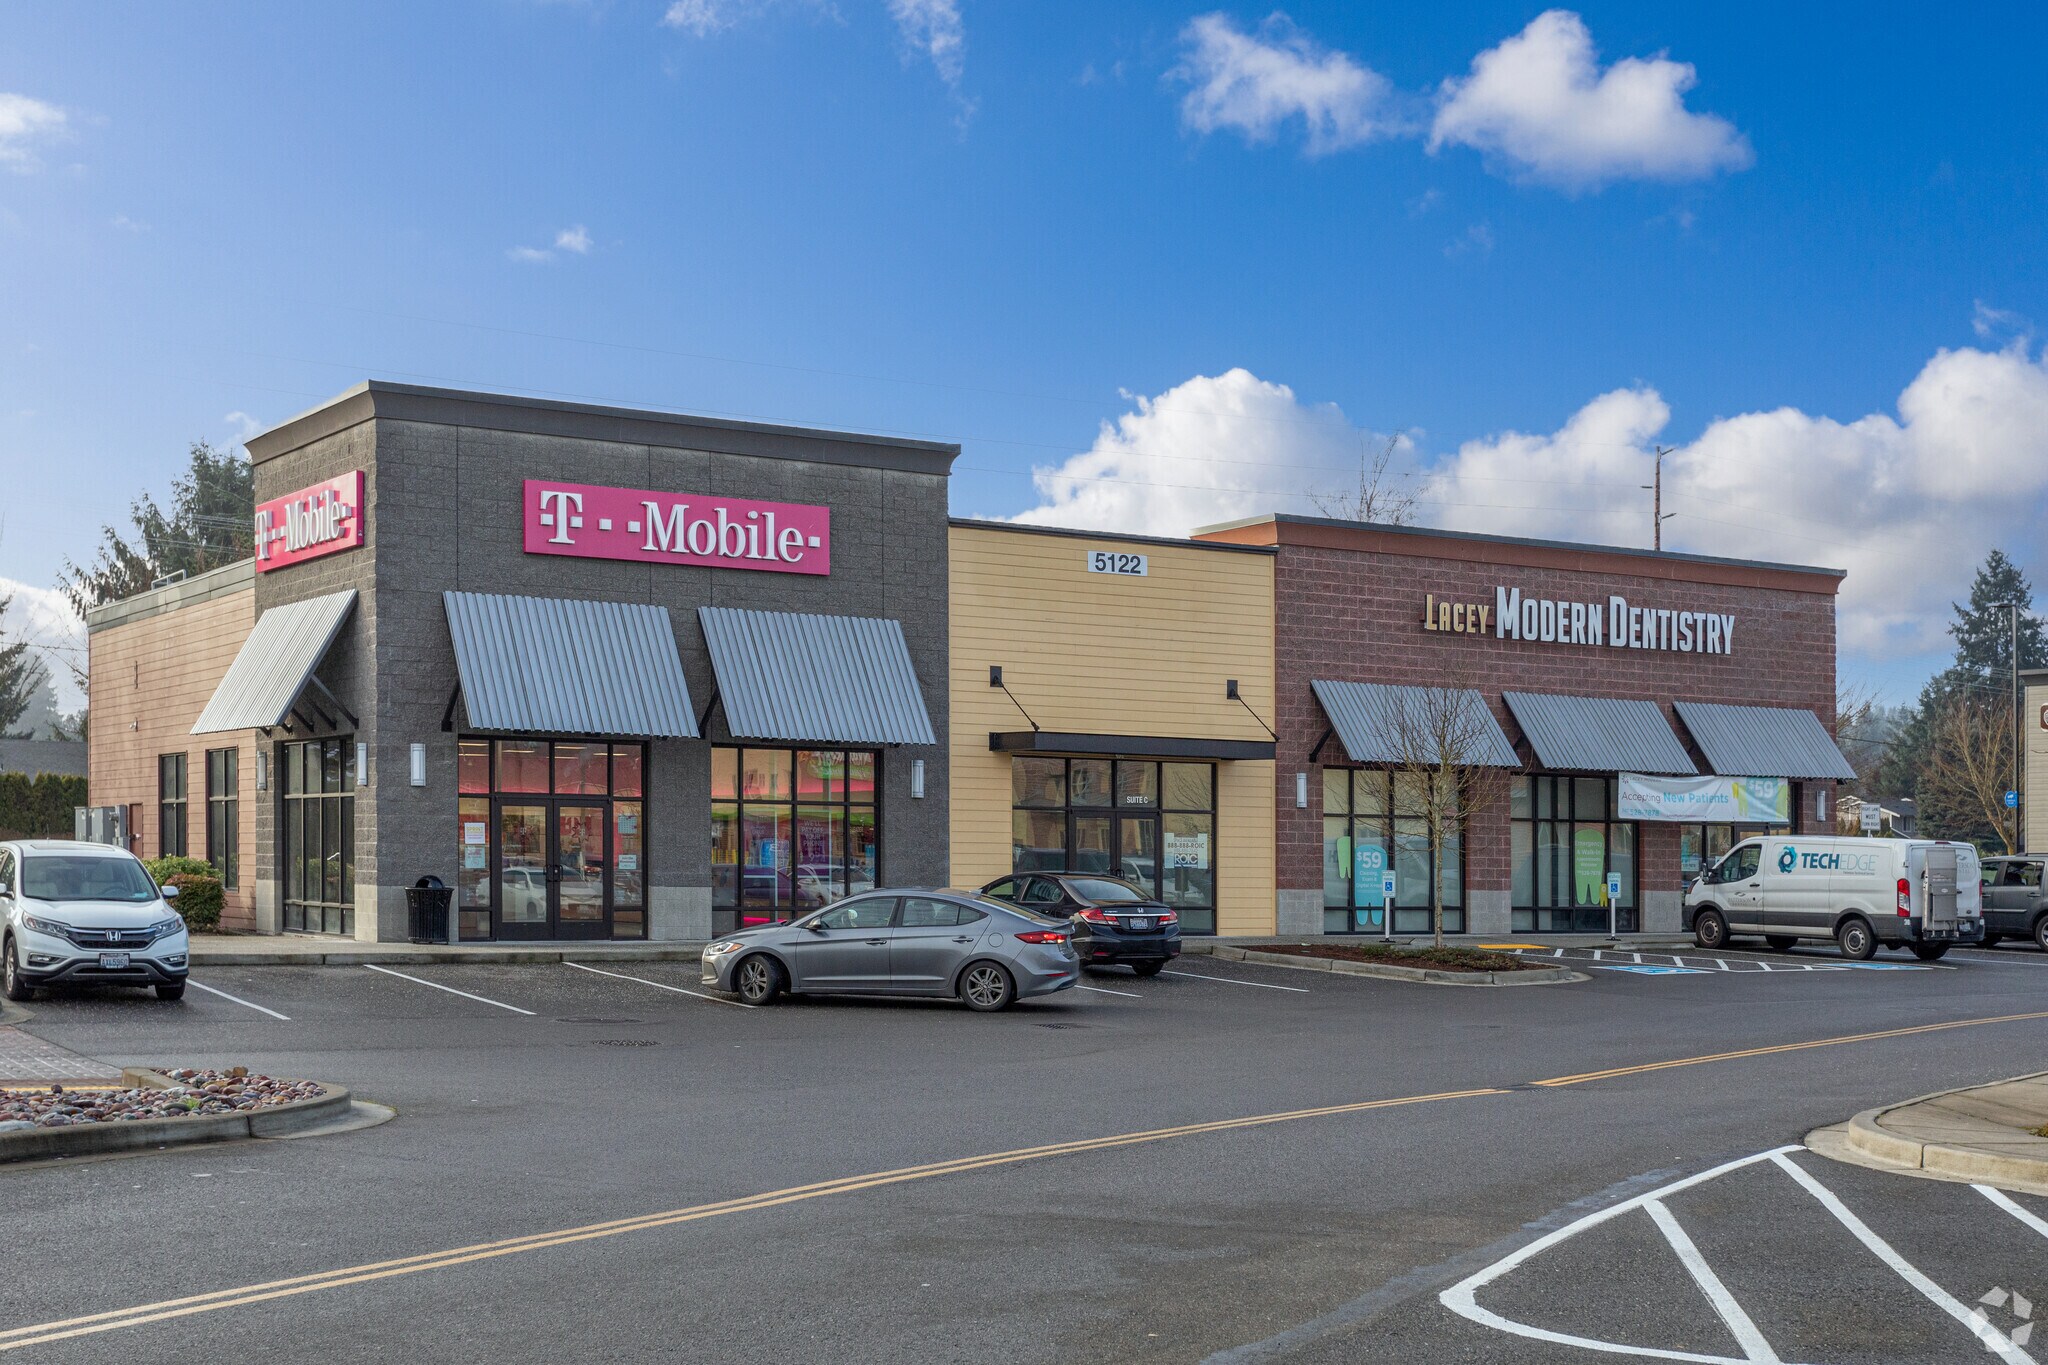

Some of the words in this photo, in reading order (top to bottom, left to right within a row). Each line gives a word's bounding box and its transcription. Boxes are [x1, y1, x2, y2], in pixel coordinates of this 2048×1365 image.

[1094, 552, 1141, 575] 5122
[1425, 594, 1489, 634] LACEY
[1496, 586, 1602, 645] MODERN
[1609, 595, 1735, 655] DENTISTRY
[1621, 791, 1660, 804] Accepting
[1663, 792, 1685, 803] New
[1689, 793, 1729, 804] Patients
[1748, 779, 1774, 798] $59
[1126, 795, 1143, 804] SUITE
[1143, 796, 1149, 804] C
[1174, 853, 1198, 864] ROIC
[1356, 851, 1382, 869] $59
